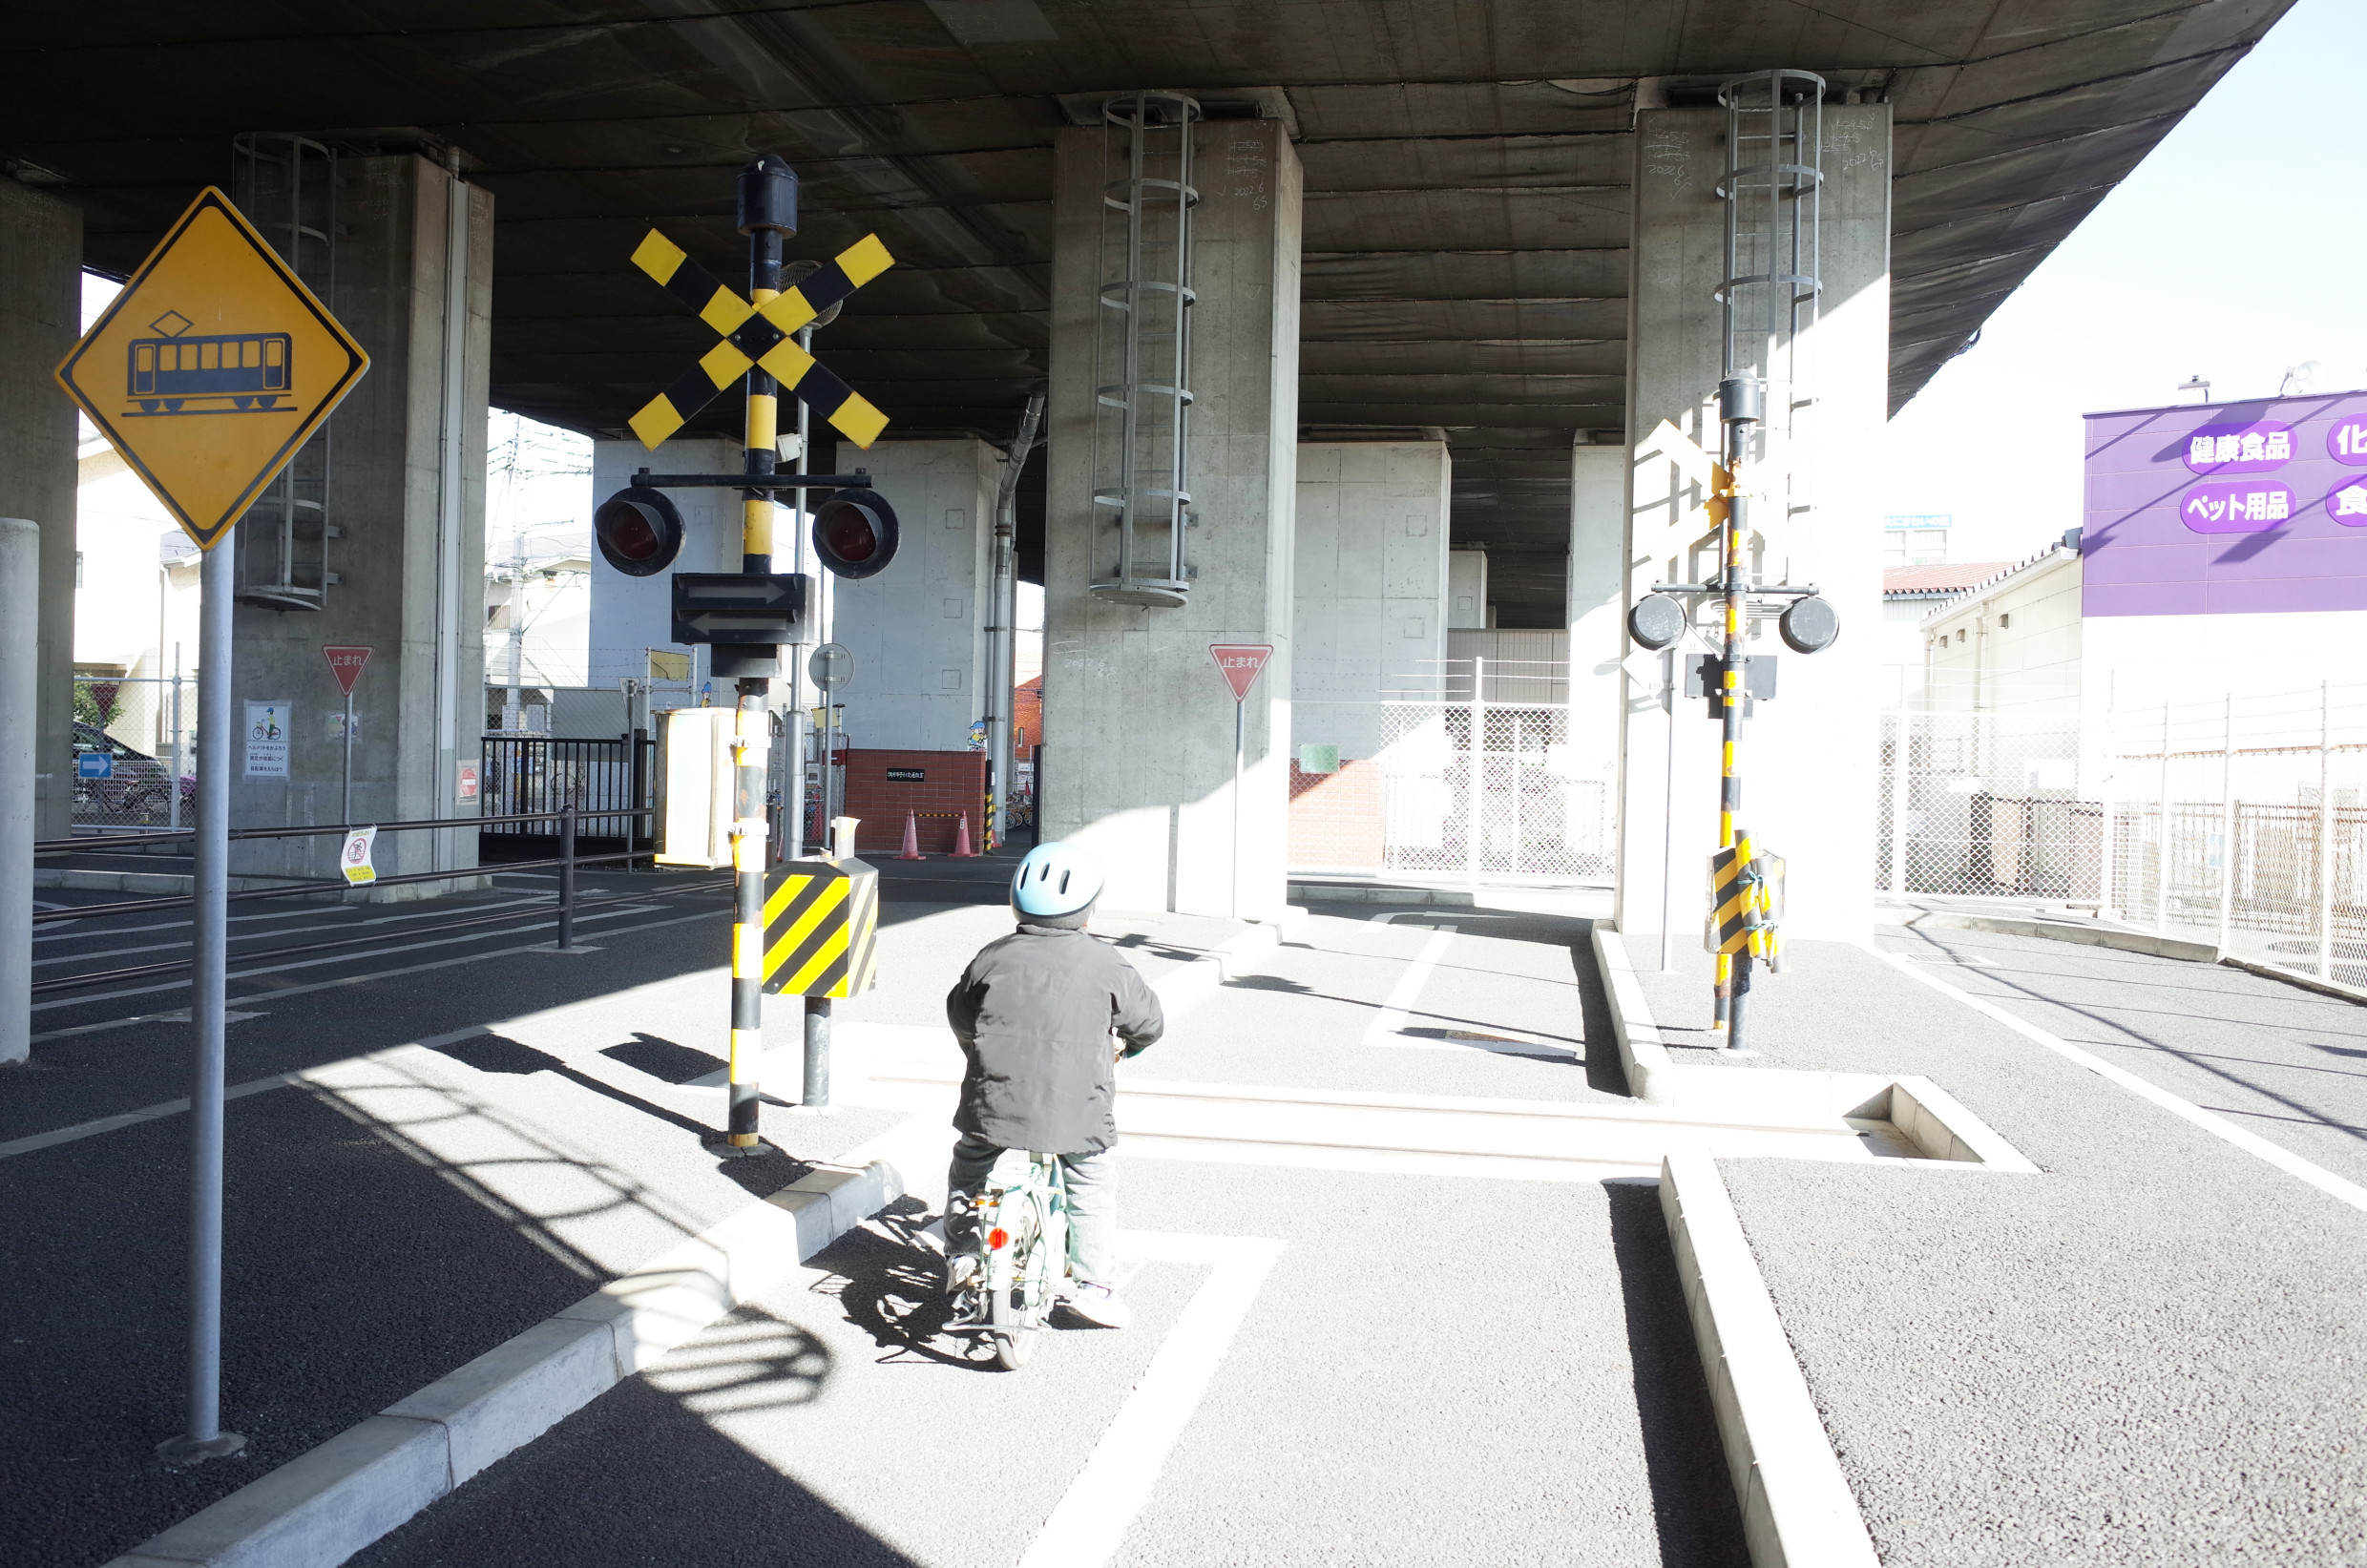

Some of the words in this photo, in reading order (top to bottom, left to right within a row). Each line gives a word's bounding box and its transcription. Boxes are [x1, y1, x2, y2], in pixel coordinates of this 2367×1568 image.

[2189, 431, 2291, 465] 健康食品
[2188, 491, 2289, 521] ペット用品
[333, 655, 363, 666] 止まれ
[1223, 656, 1260, 668] 止まれ
